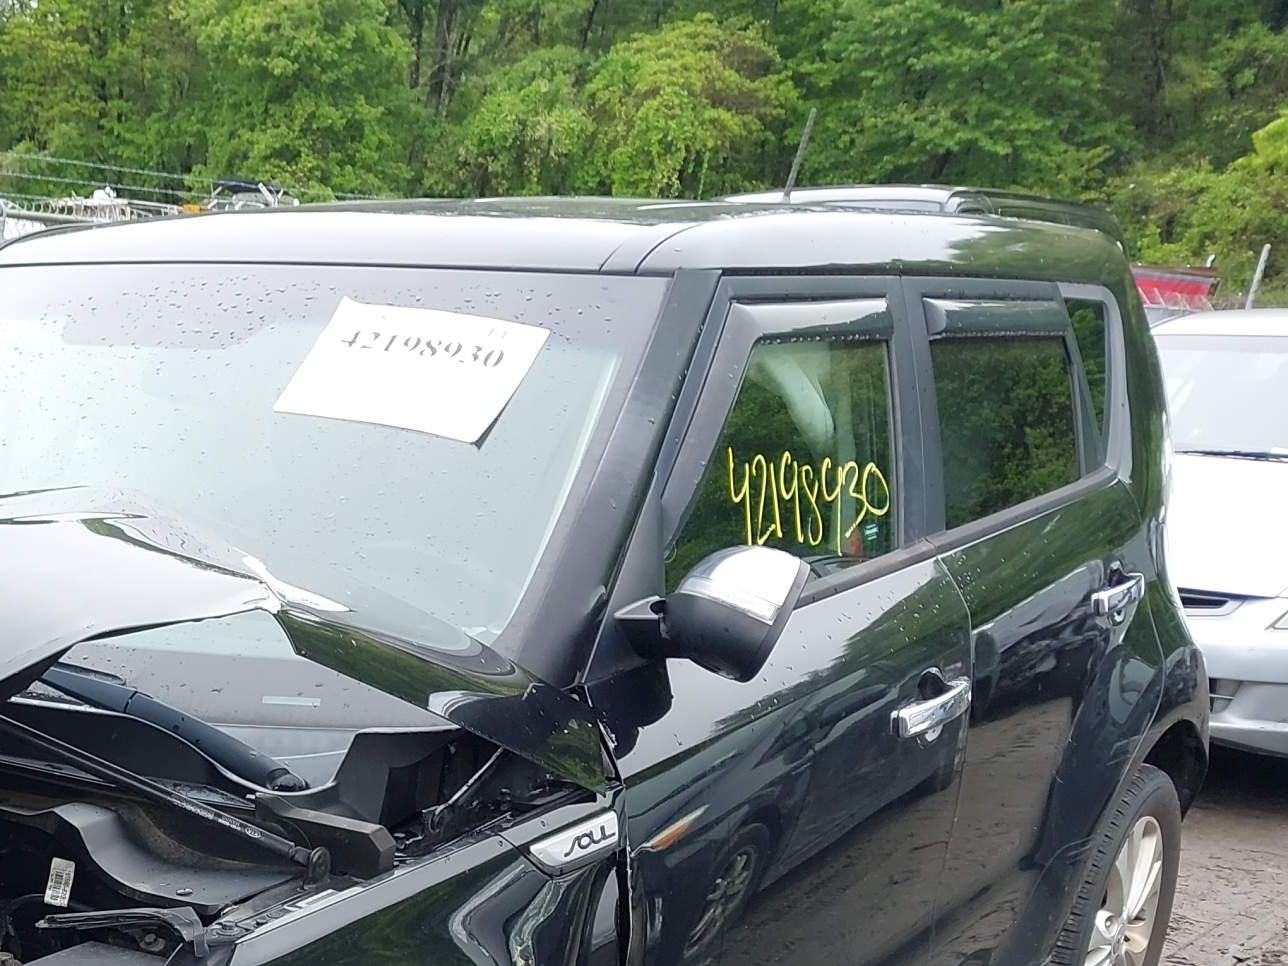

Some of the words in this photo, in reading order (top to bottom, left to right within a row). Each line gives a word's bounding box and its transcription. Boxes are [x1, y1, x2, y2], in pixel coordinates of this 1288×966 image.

[340, 329, 505, 369] 42198930
[727, 446, 890, 556] 42198930
[563, 824, 617, 858] SOUL
